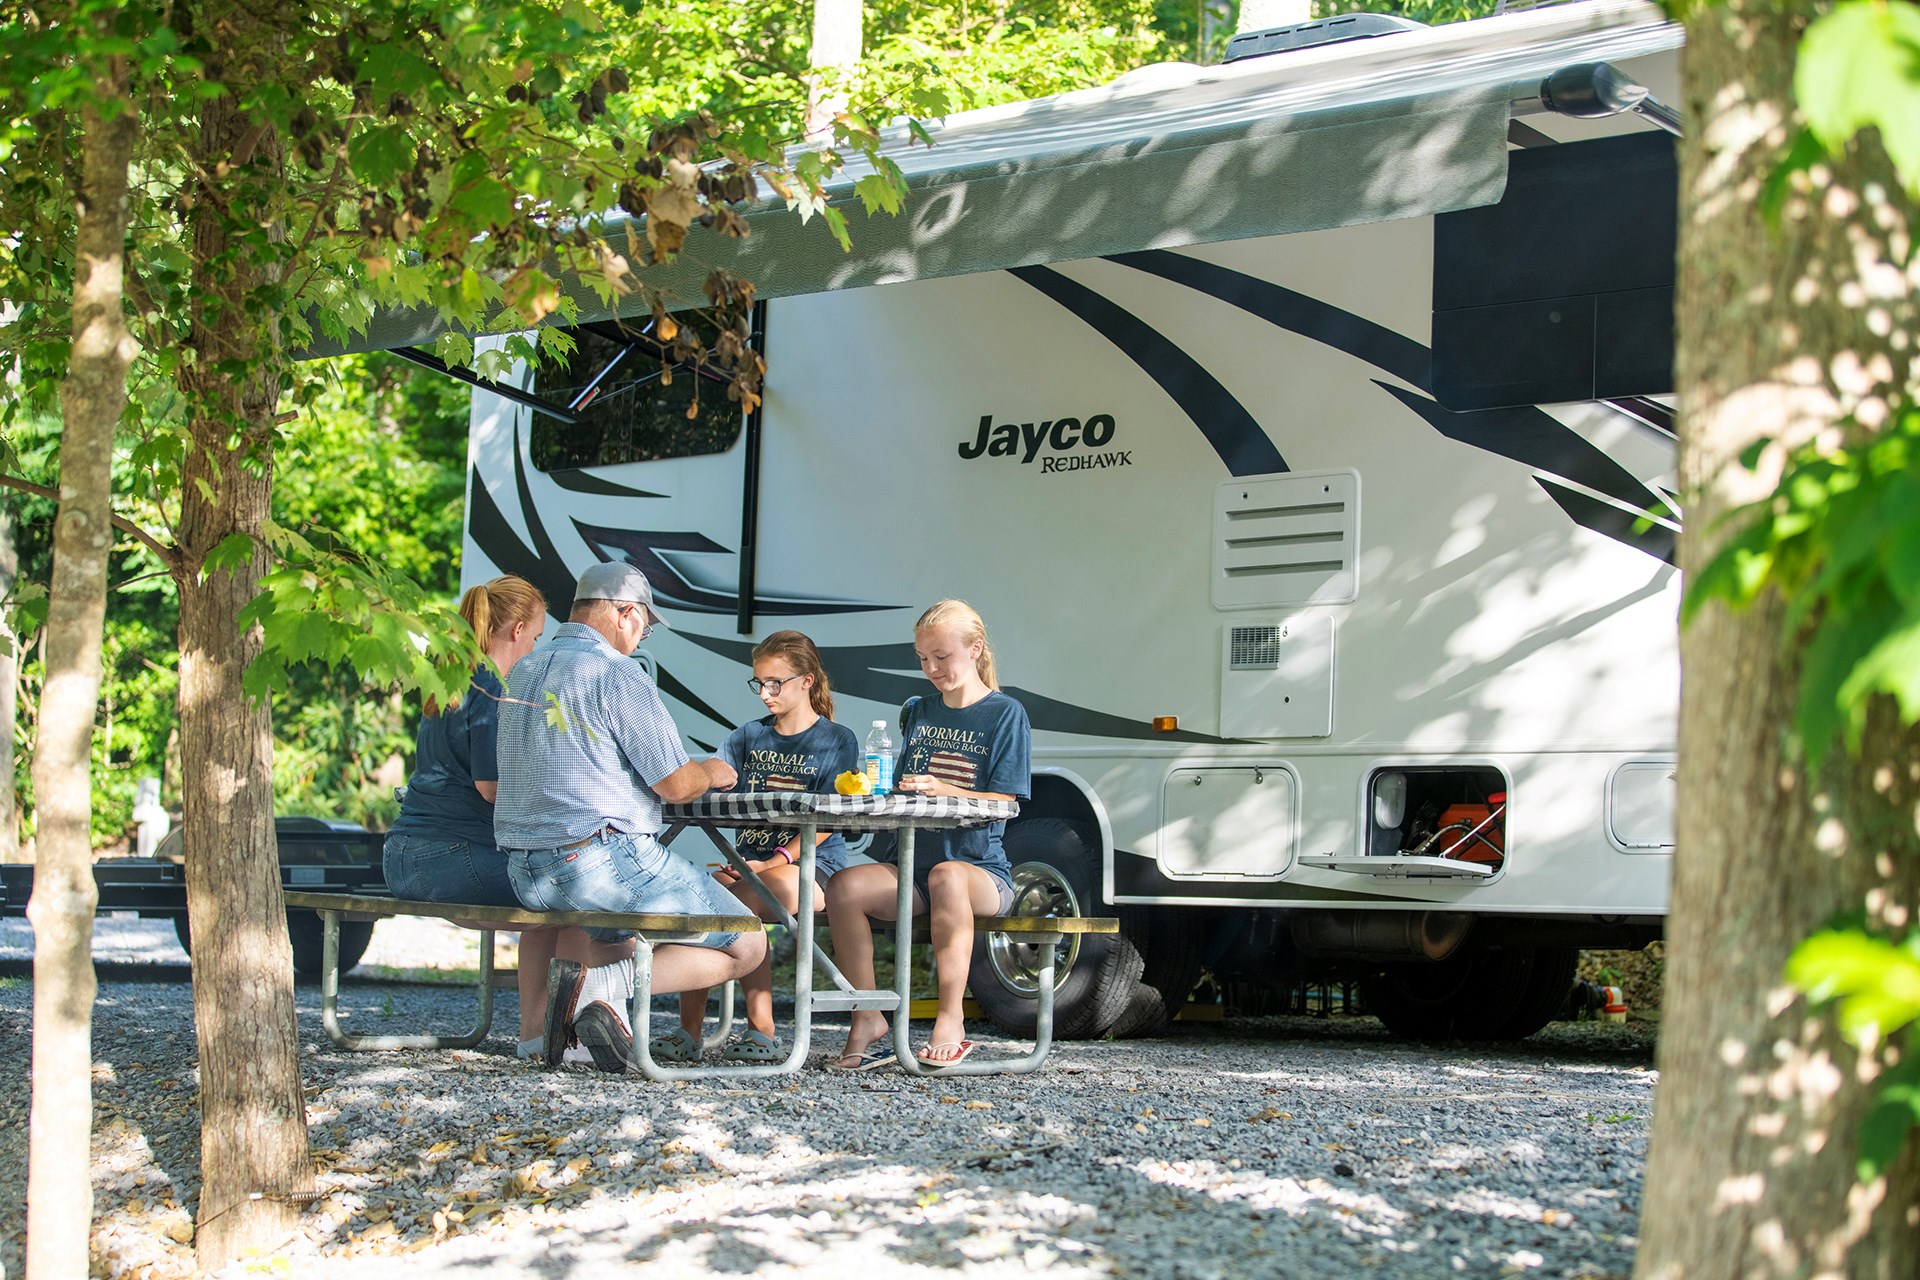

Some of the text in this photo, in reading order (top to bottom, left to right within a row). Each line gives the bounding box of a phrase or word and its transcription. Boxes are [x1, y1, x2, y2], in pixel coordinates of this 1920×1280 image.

[958, 413, 1116, 464] Jayco
[1041, 450, 1133, 473] REDHAWK
[923, 738, 960, 750] COMING
[961, 743, 989, 756] BACK
[756, 762, 791, 774] COMING
[791, 766, 818, 776] BACK
